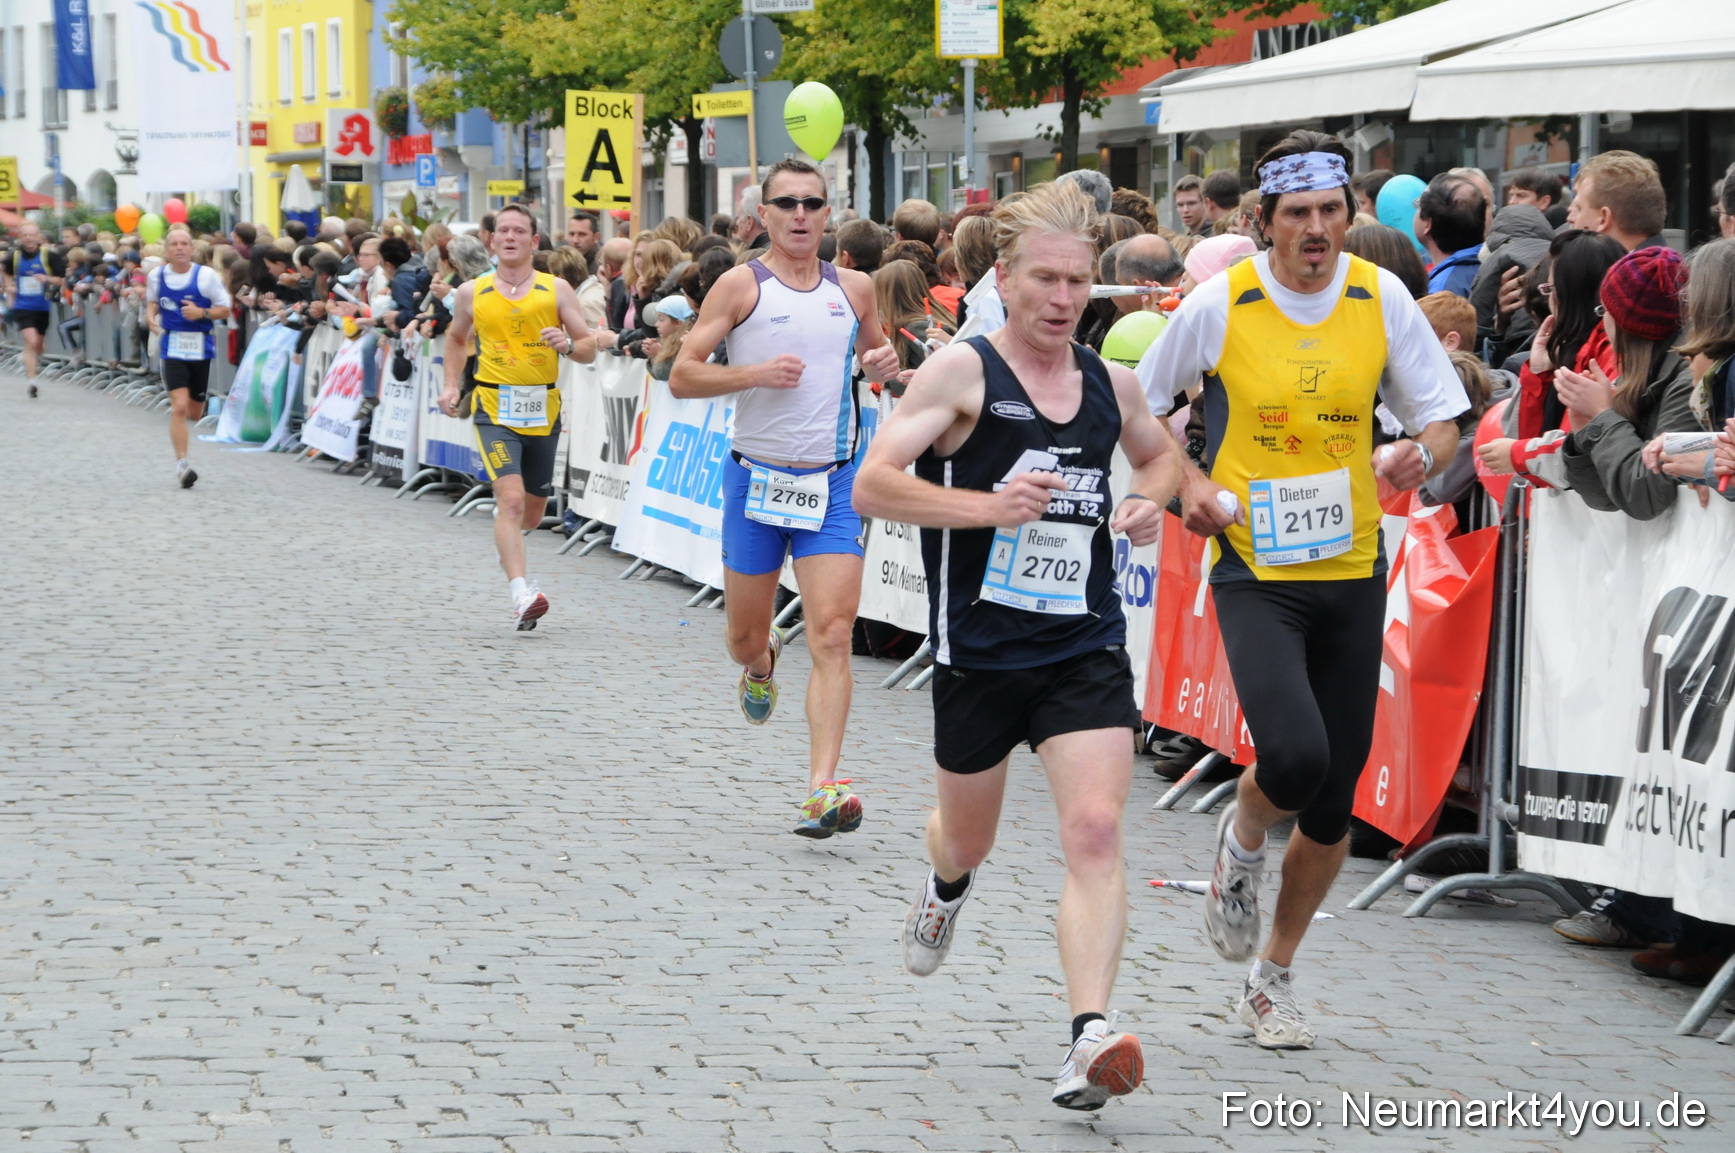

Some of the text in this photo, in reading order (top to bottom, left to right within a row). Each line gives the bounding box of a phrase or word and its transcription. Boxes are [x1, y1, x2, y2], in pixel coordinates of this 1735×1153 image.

[71, 17, 86, 55] K&L
[575, 96, 633, 119] Block
[706, 98, 743, 110] Toiletten
[580, 128, 623, 184] A
[420, 157, 432, 183] P
[514, 401, 542, 413] 2188
[1258, 411, 1288, 423] Seidl
[1323, 433, 1356, 445] PIZZERIA
[1328, 442, 1353, 453] ELIO
[754, 483, 760, 491] A
[773, 476, 794, 486] Kurt
[771, 488, 819, 509] 2786
[1279, 487, 1320, 503] Dieter
[1078, 501, 1099, 517] 52
[1259, 512, 1266, 525] A
[1283, 503, 1344, 534] 2179
[1027, 528, 1068, 549] Reiner
[998, 547, 1006, 560] A
[1021, 555, 1081, 582] 2702
